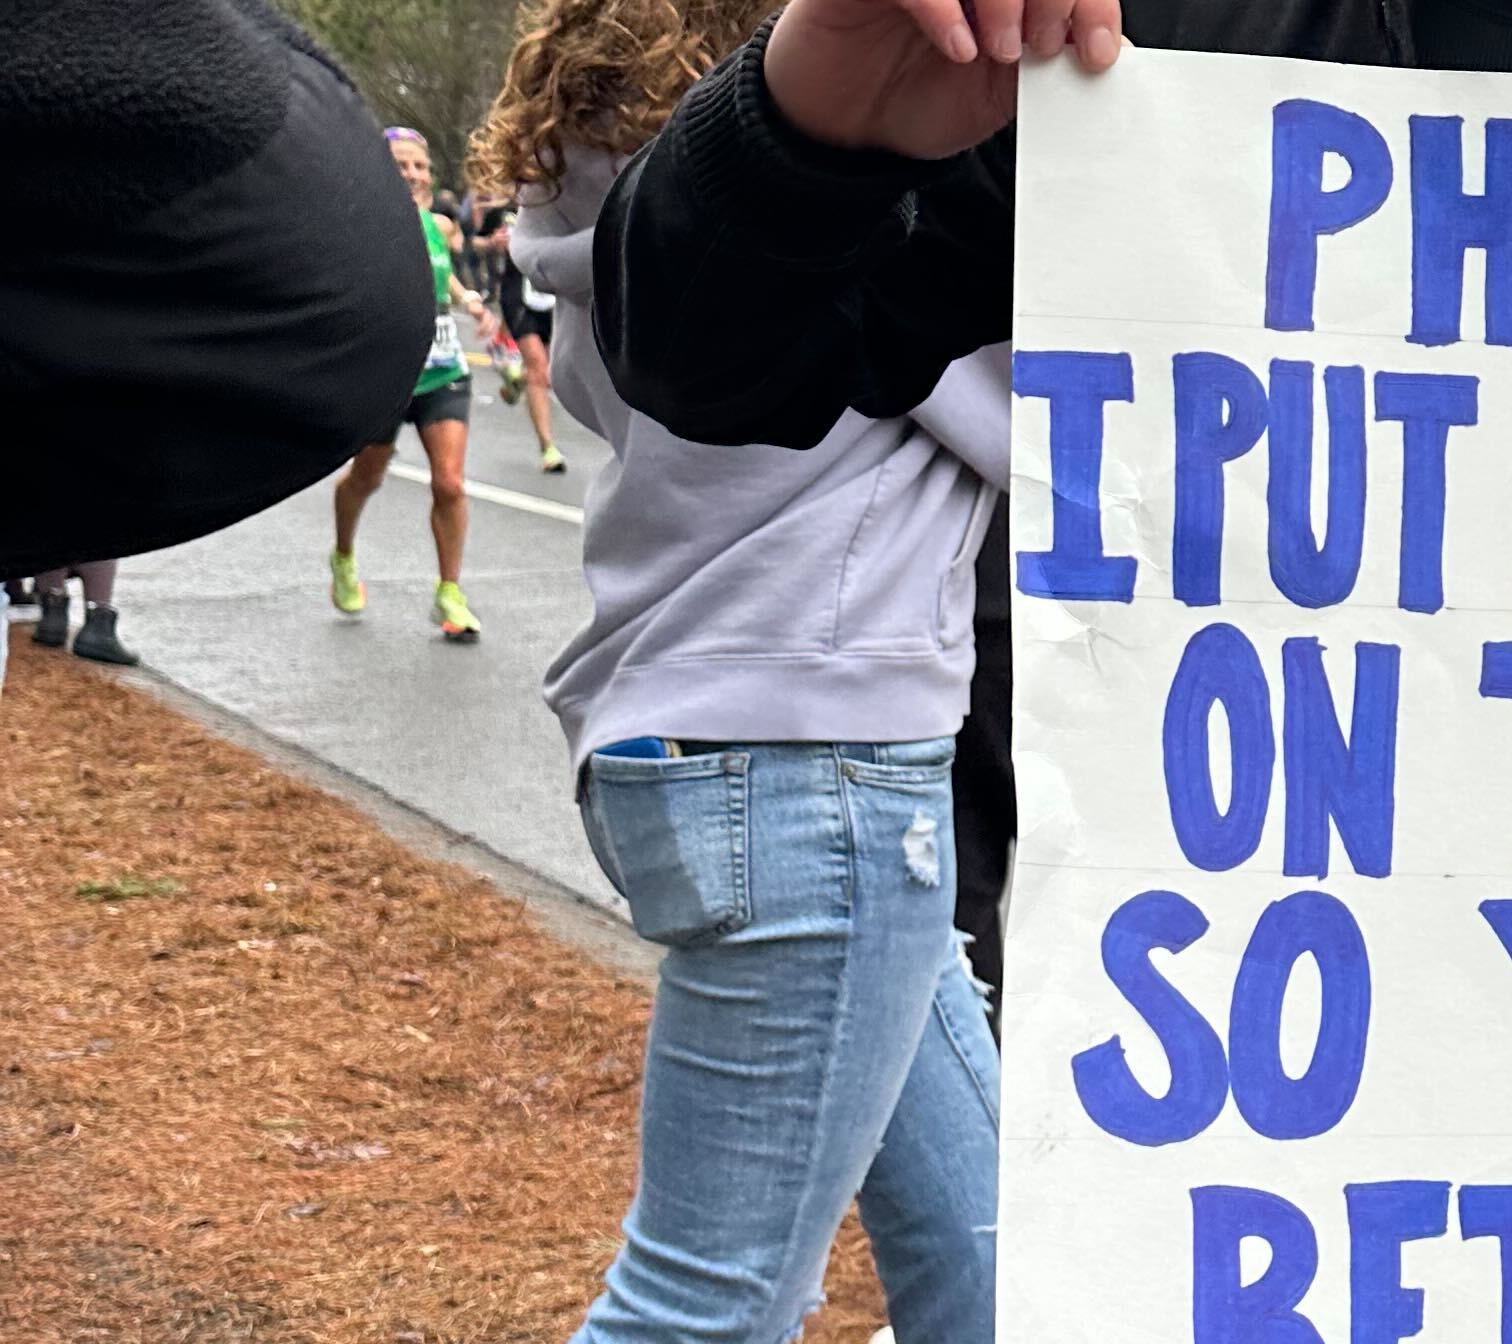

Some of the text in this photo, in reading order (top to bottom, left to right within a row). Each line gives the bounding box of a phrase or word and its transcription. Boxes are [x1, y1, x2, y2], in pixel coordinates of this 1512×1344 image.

[1012, 350, 1137, 603] I
[1172, 351, 1480, 614] PUT
[1162, 622, 1400, 880] ON
[1071, 890, 1372, 1146] SO
